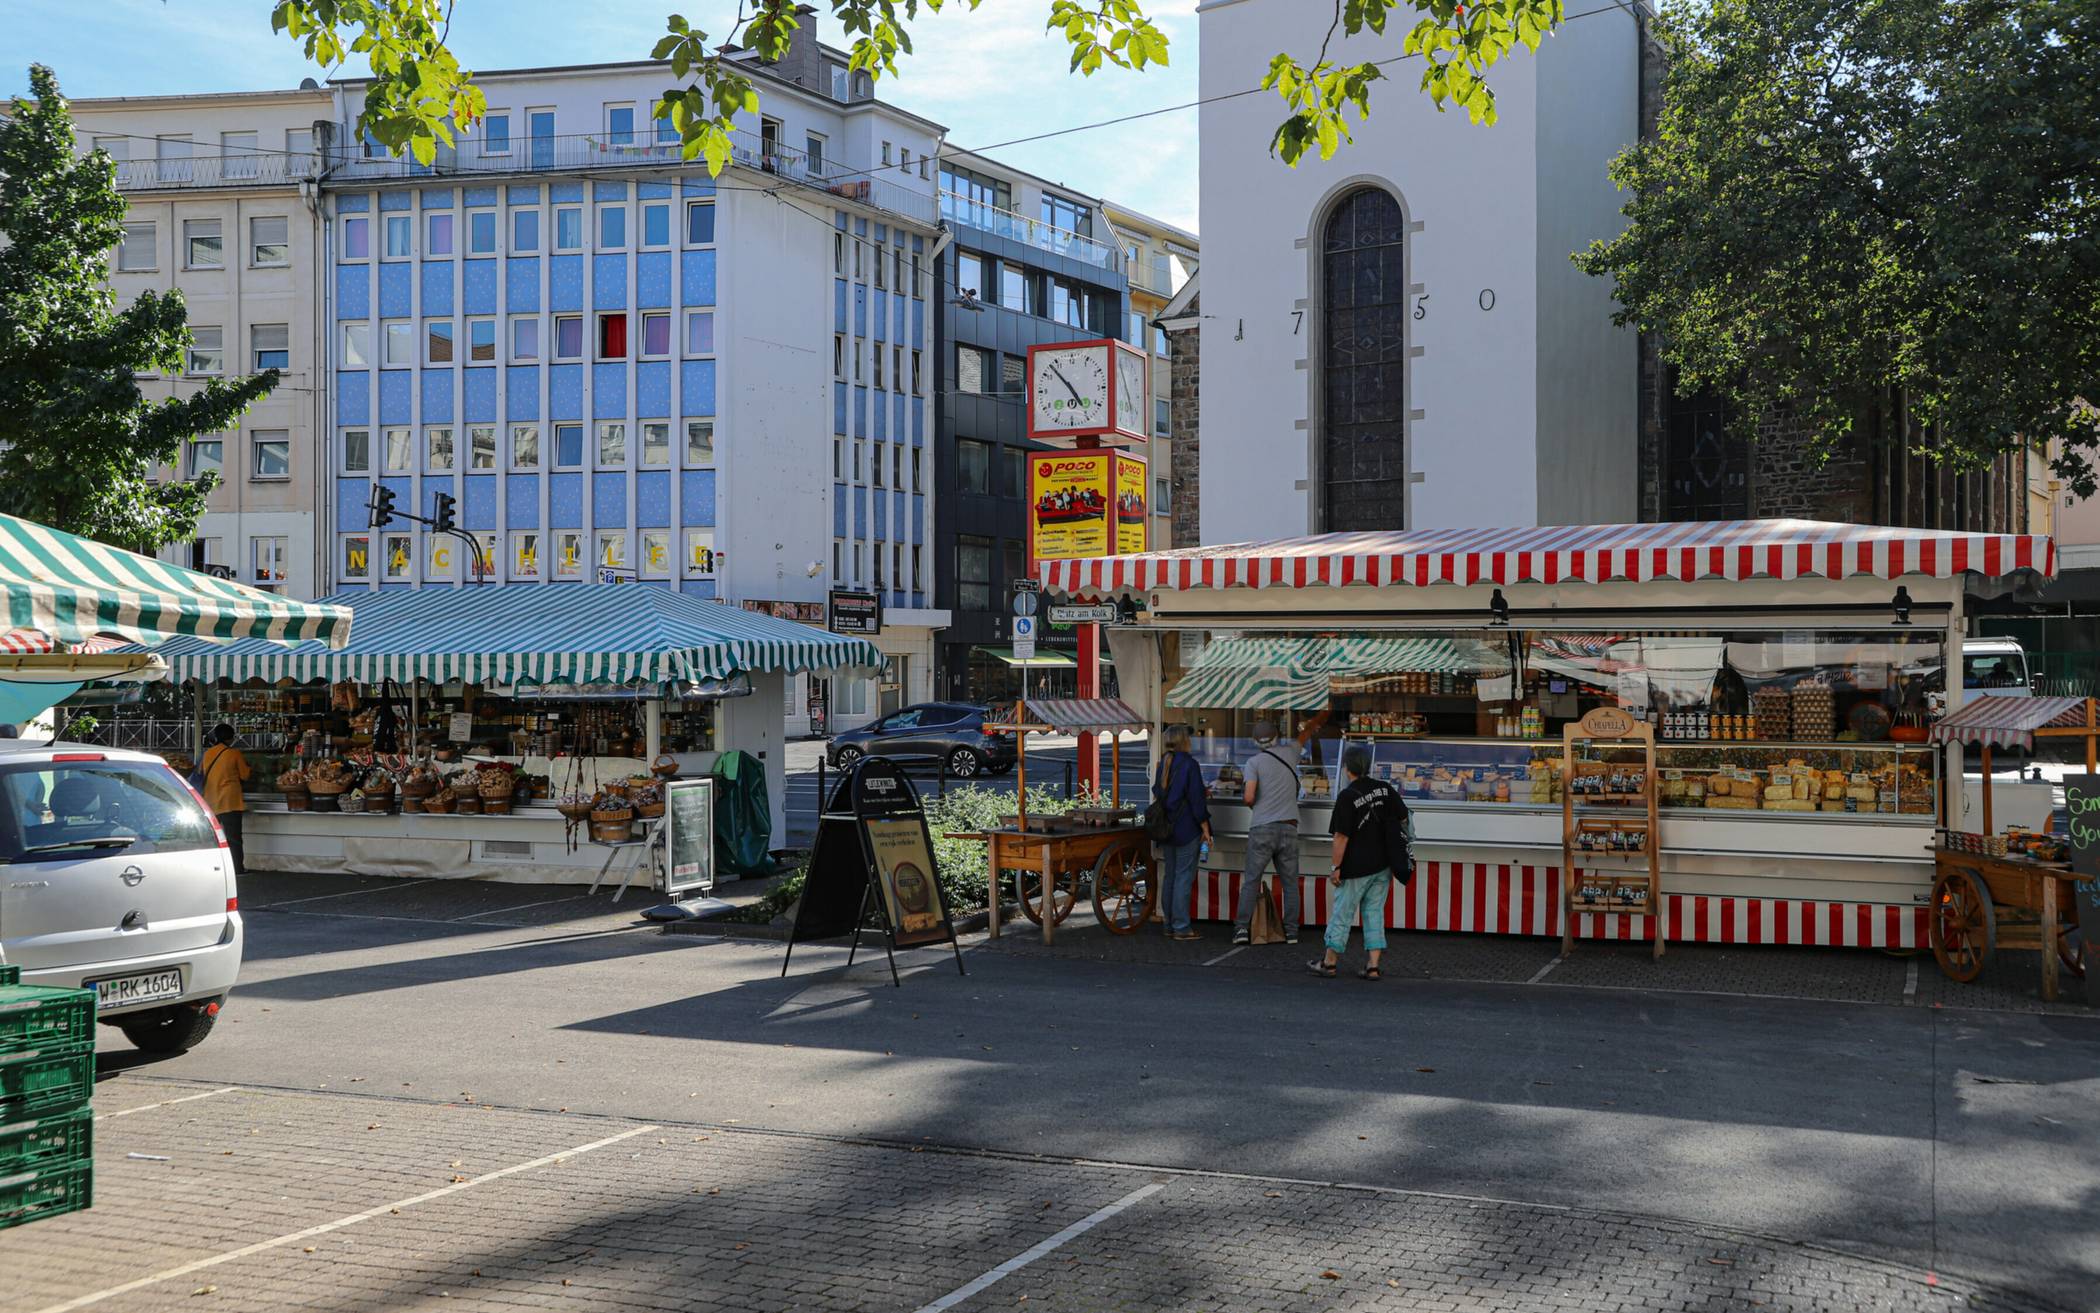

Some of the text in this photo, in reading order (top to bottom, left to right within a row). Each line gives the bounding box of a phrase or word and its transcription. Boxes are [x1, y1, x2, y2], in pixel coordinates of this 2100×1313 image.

[1054, 461, 1096, 473] POCO
[1125, 464, 1141, 475] POCO
[1077, 610, 1089, 618] am
[1091, 609, 1107, 618] Kolk
[99, 972, 178, 1001] W RK 1604
